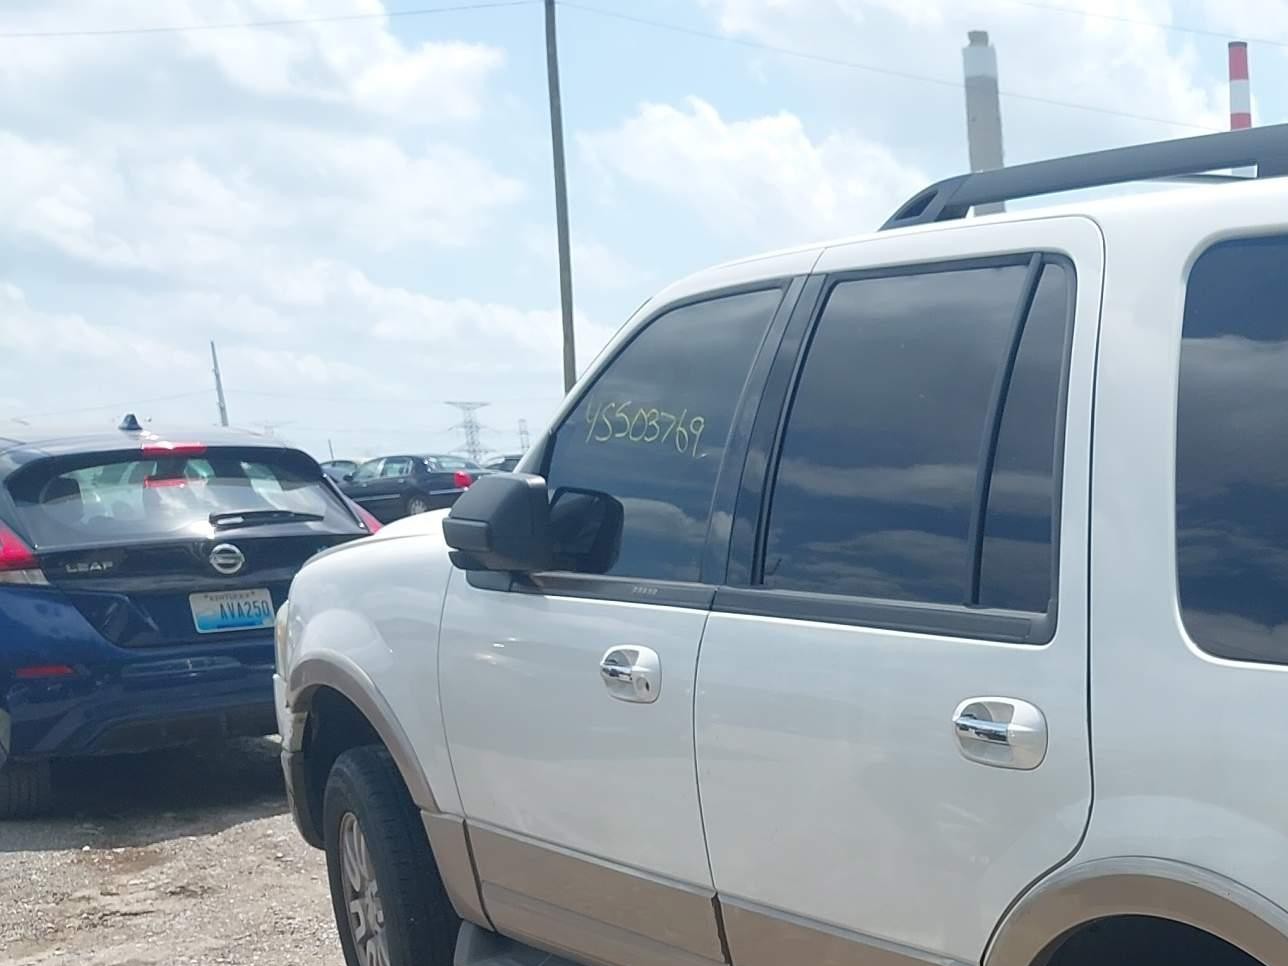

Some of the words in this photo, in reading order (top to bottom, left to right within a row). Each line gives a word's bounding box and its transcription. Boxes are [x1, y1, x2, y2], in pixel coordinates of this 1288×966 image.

[585, 400, 705, 457] 45503769
[65, 561, 113, 573] LEAF
[220, 600, 270, 619] AVA250
